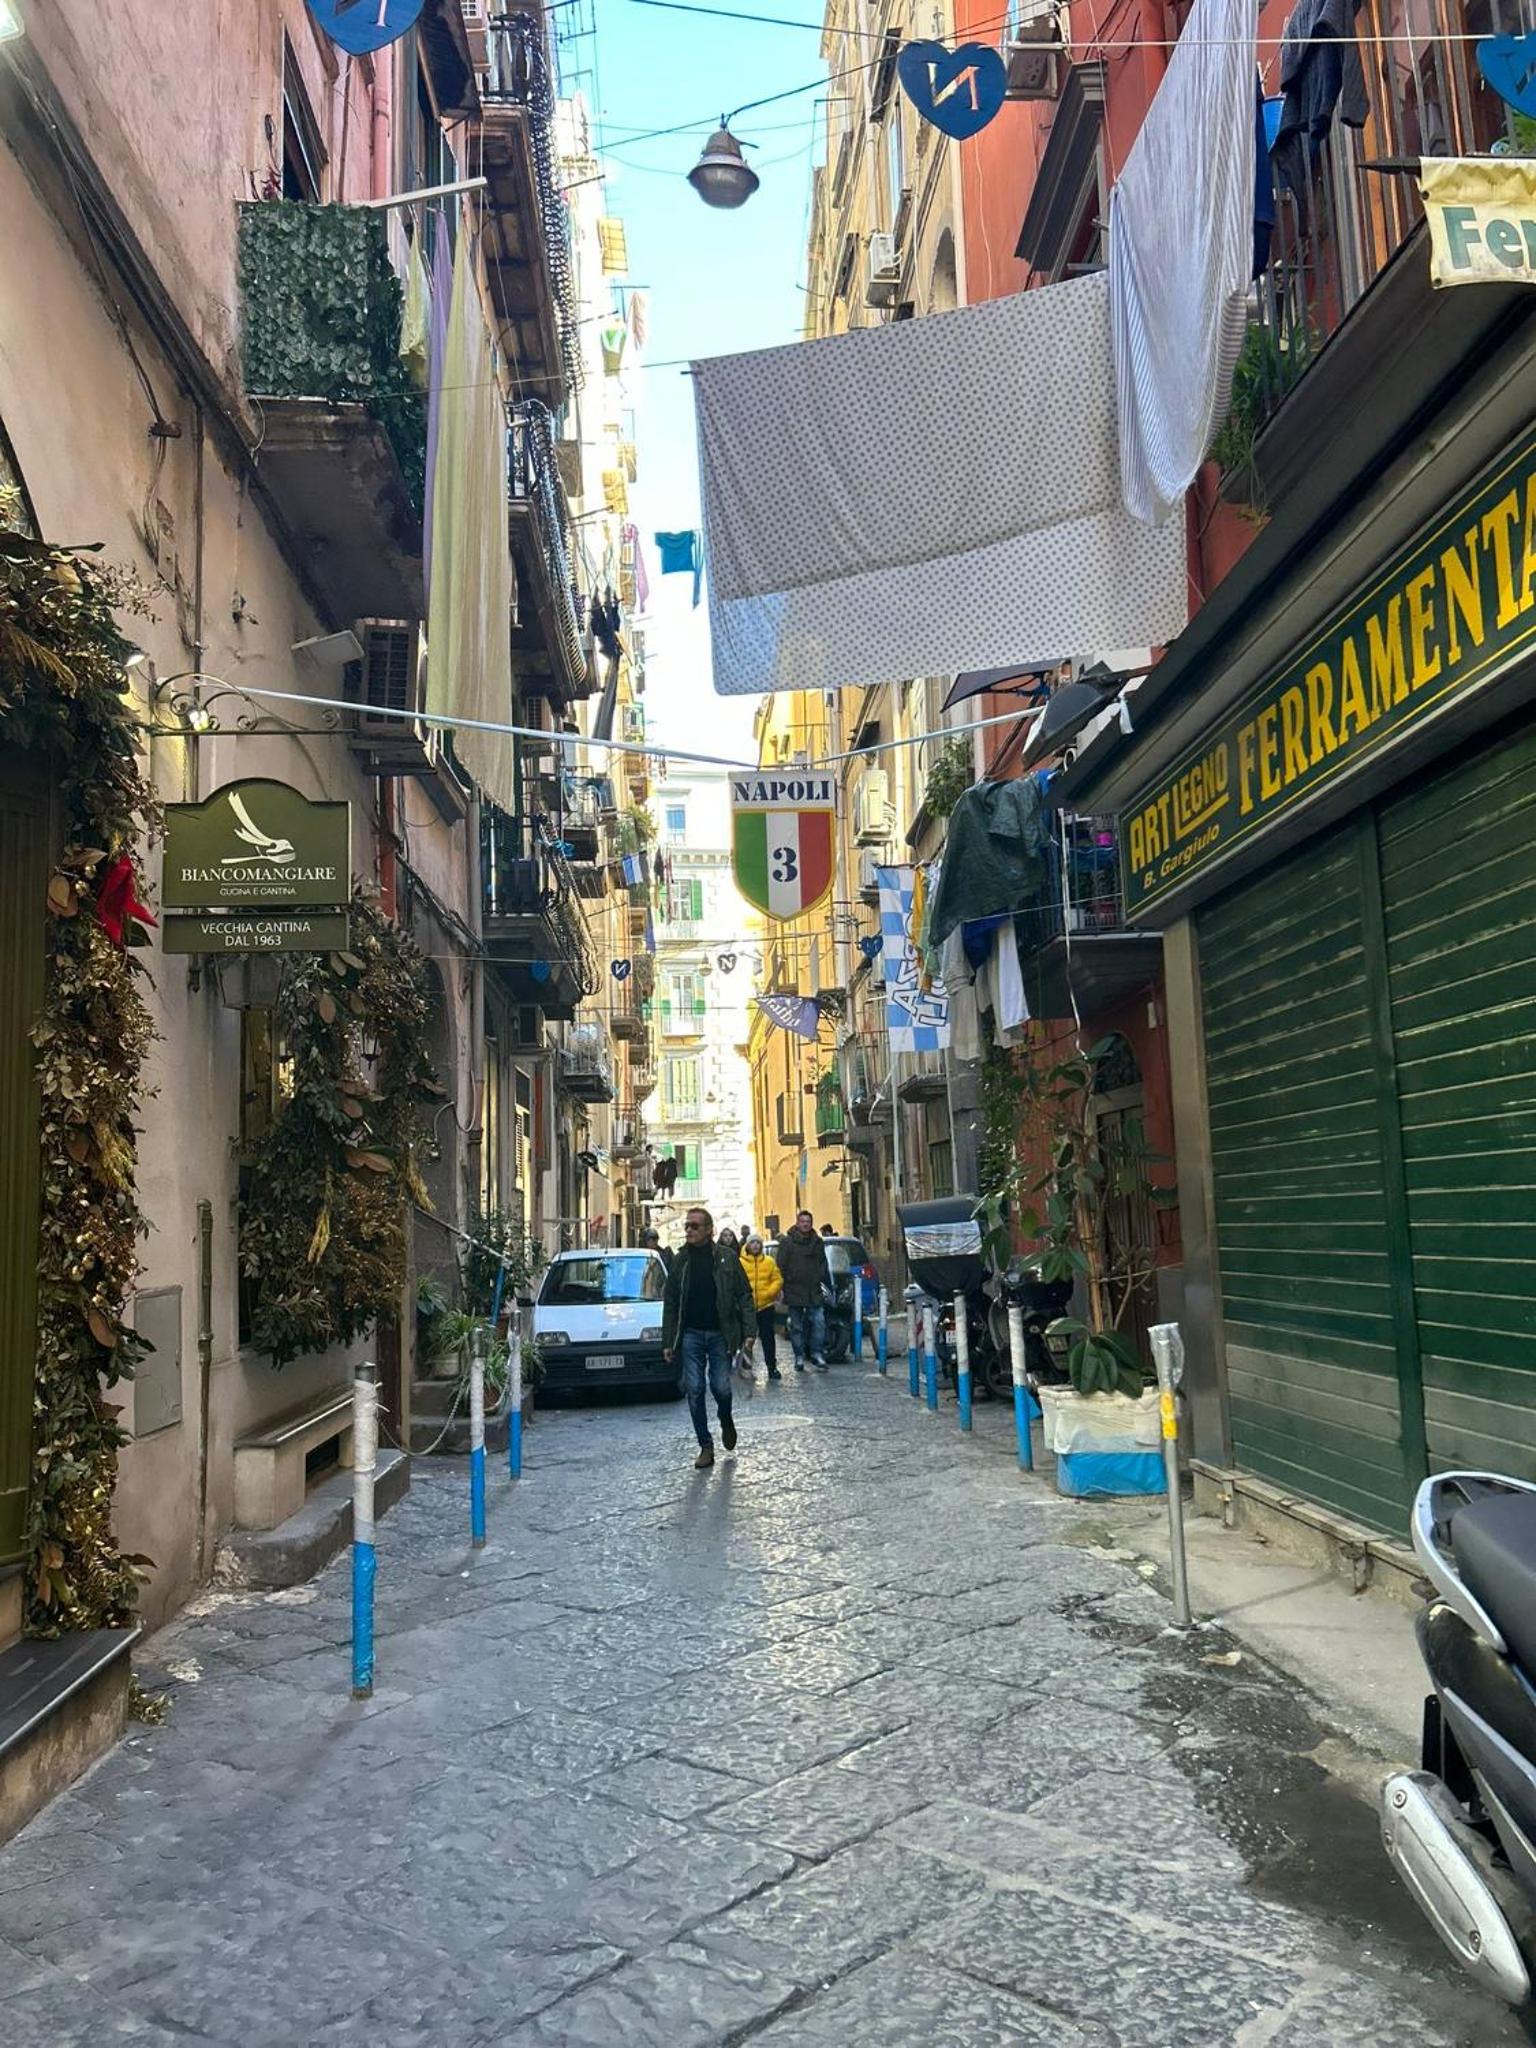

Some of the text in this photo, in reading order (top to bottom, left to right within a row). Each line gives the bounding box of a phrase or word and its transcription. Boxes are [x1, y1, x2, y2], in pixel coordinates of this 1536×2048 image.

[734, 780, 831, 802] NAPOLI
[772, 846, 799, 883] 3
[1143, 823, 1220, 890] B. Gargiulo
[181, 866, 337, 882] BIANCOMANGIARE
[219, 886, 297, 897] CUCINA E CANTINA
[201, 921, 312, 935] VECCHIA CANTINA
[225, 934, 283, 948] DAL 1963
